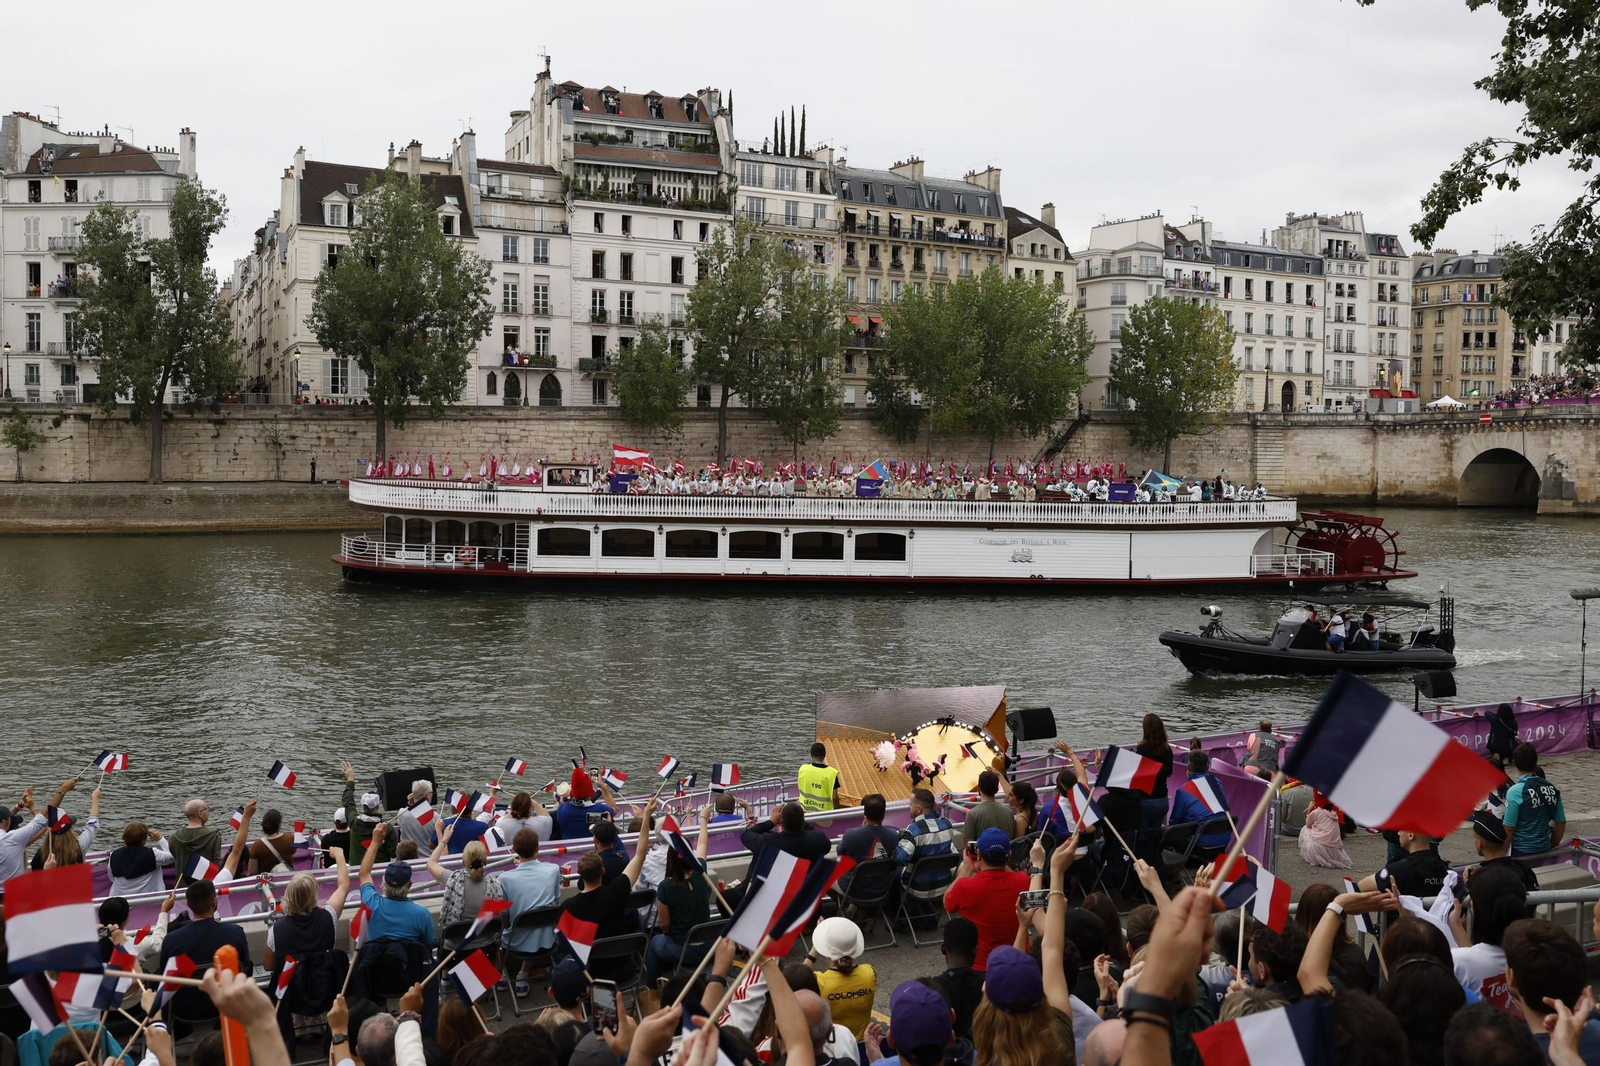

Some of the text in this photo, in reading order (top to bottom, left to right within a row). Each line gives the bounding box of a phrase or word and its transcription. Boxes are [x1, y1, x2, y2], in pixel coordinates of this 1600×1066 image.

[1527, 785, 1556, 798] PRIS
[1424, 877, 1444, 885] POLI
[827, 988, 873, 1001] COLOMBIA
